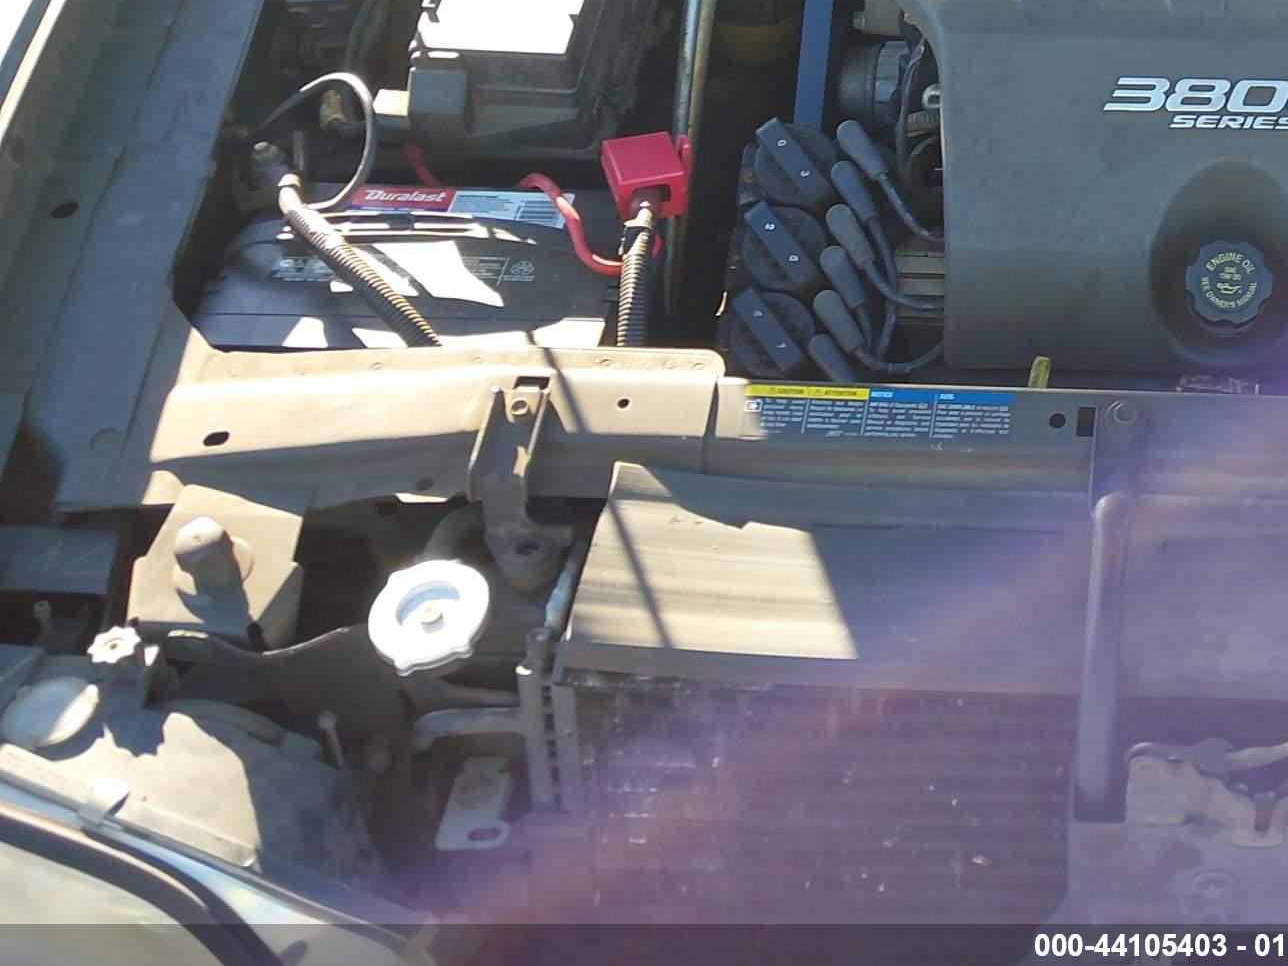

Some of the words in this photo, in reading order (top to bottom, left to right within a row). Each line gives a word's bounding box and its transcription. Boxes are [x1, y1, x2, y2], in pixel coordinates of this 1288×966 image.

[365, 188, 448, 203] Duralast
[1205, 252, 1243, 272] ENGINE
[1242, 259, 1256, 275] OIL
